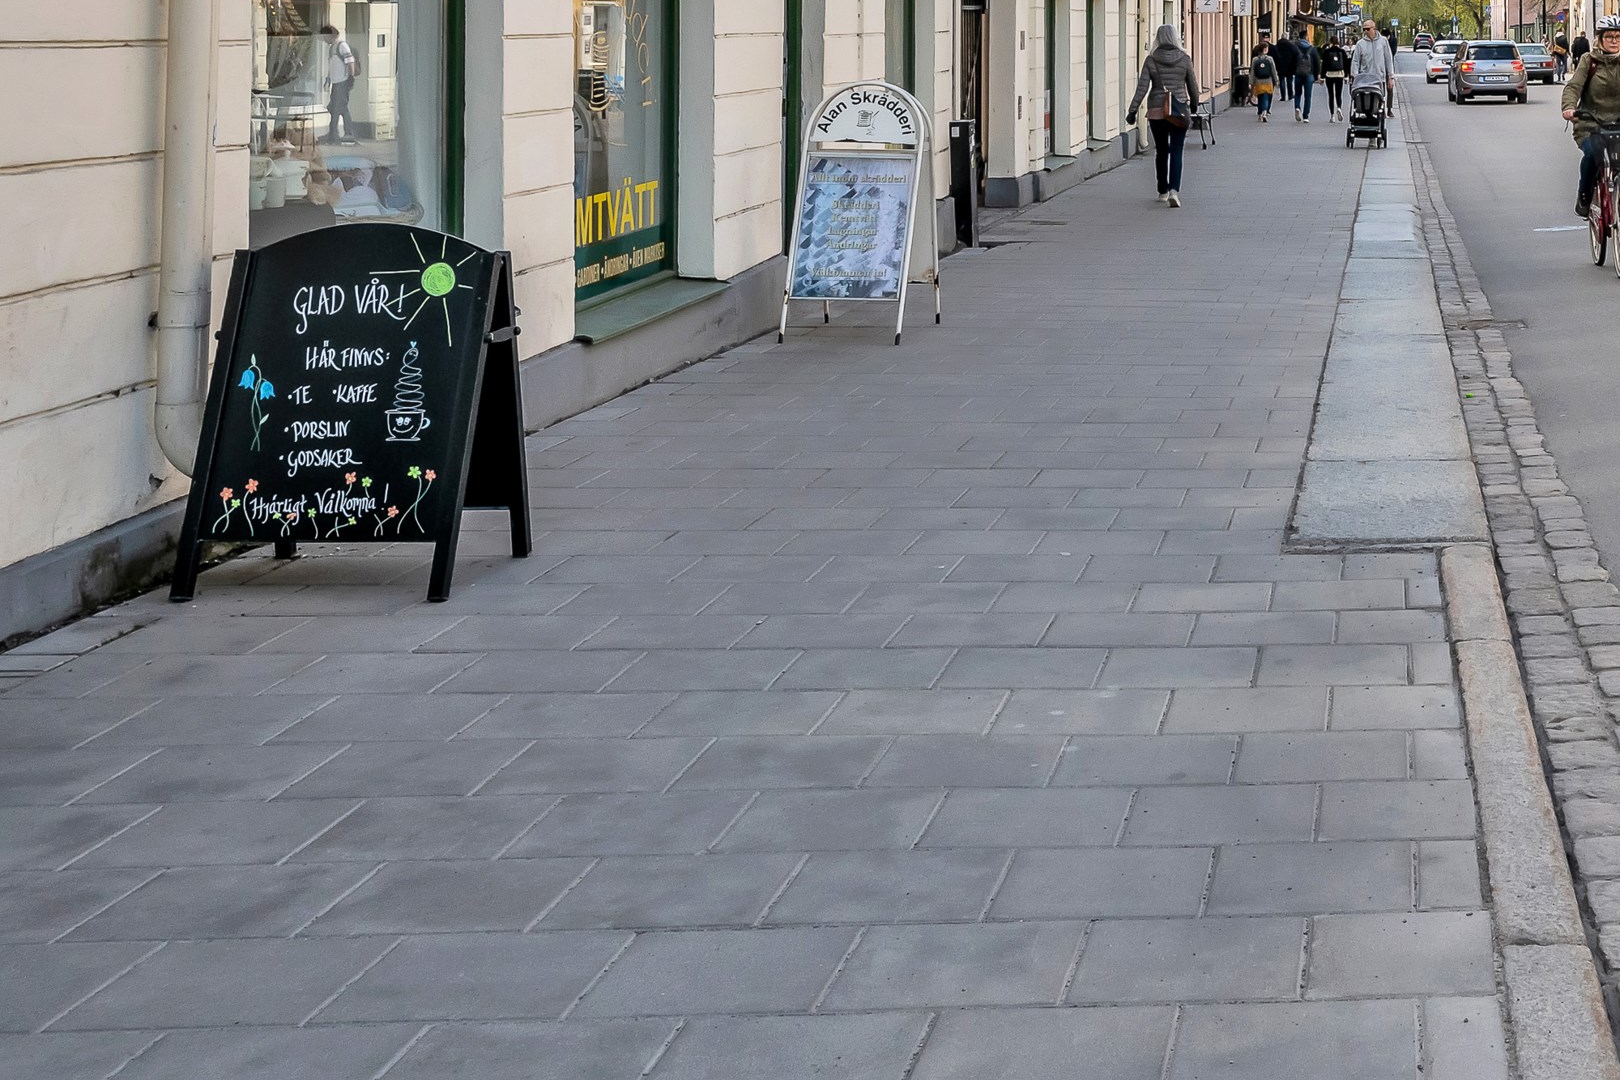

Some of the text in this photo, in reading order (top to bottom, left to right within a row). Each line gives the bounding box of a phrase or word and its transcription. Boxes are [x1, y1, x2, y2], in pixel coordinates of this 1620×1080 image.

[817, 91, 915, 135] Alan Skrädderi
[576, 177, 658, 247] MTVÄTT
[293, 278, 407, 334] GLAD VÅR!
[306, 340, 342, 371] HÄR
[288, 448, 363, 477] GODSAKER
